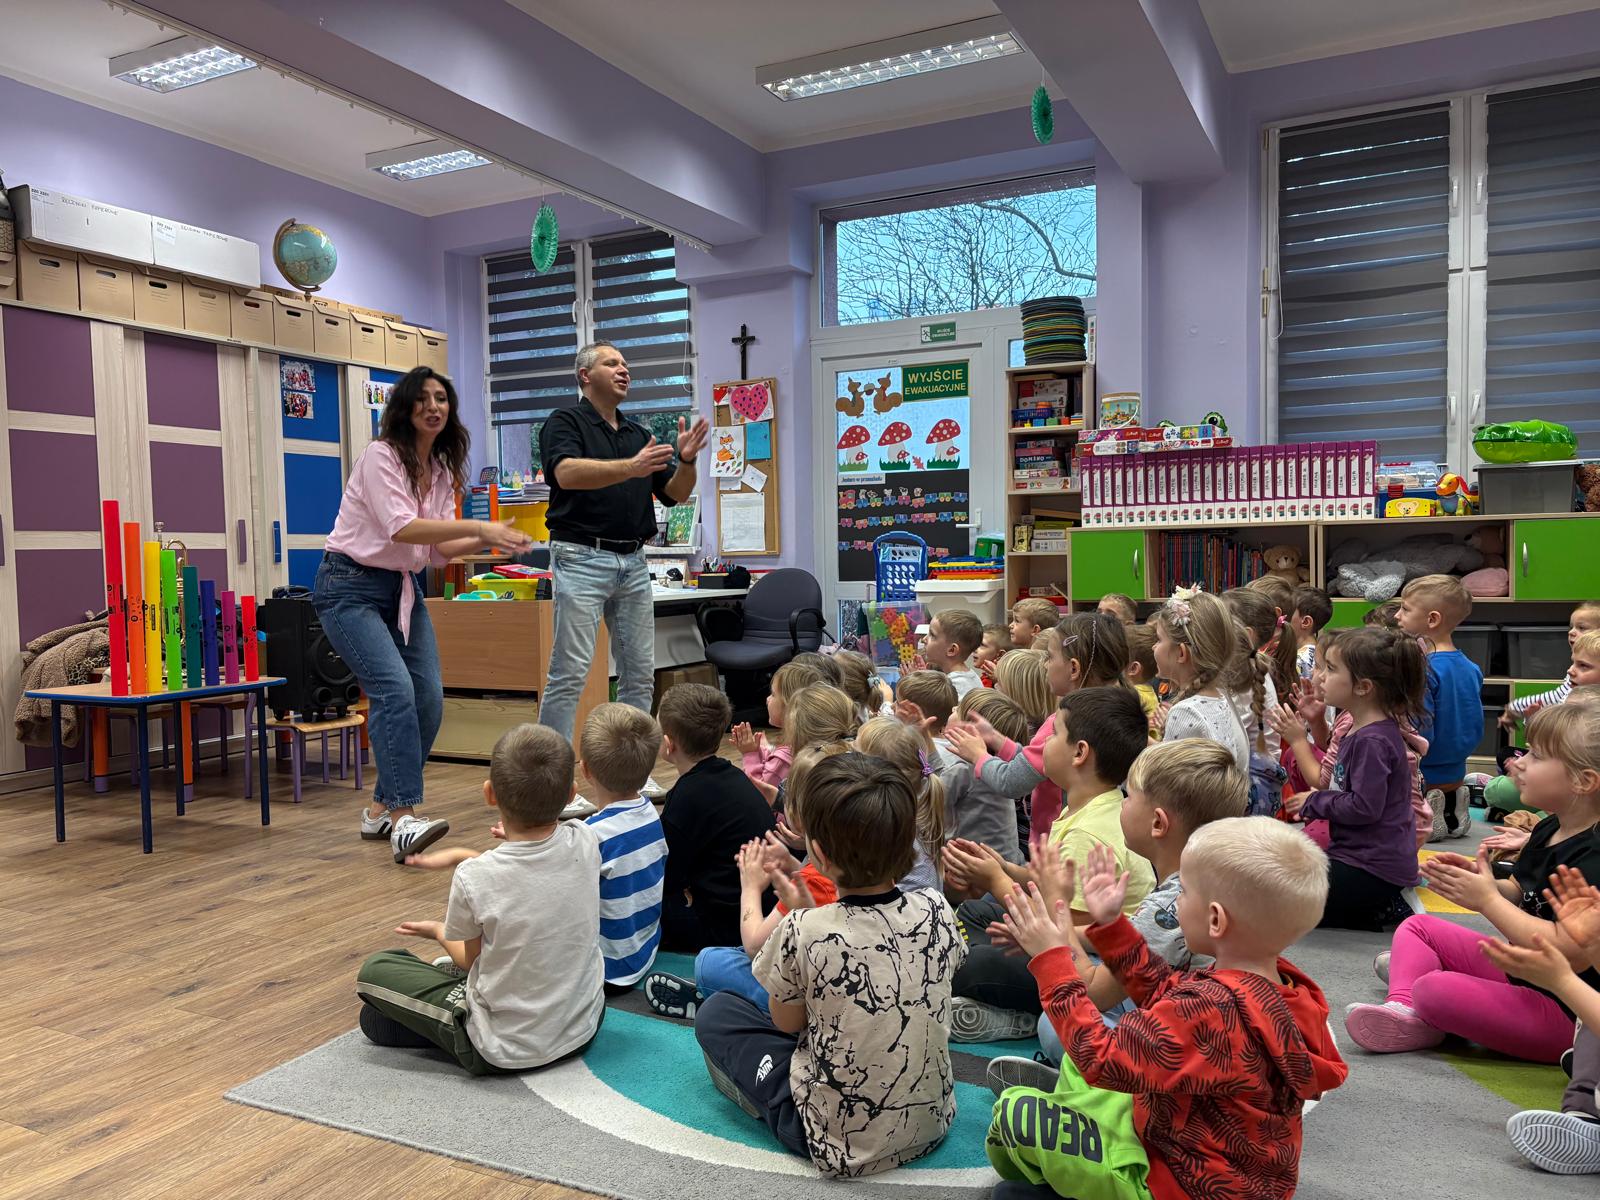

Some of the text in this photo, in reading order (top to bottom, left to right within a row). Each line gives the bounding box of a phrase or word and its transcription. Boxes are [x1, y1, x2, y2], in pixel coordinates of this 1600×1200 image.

[908, 368, 964, 384] WYJŚCIE
[904, 382, 967, 395] EWAKUACYJNE
[758, 1060, 774, 1082] NIKE
[1000, 1096, 1103, 1163] READY
